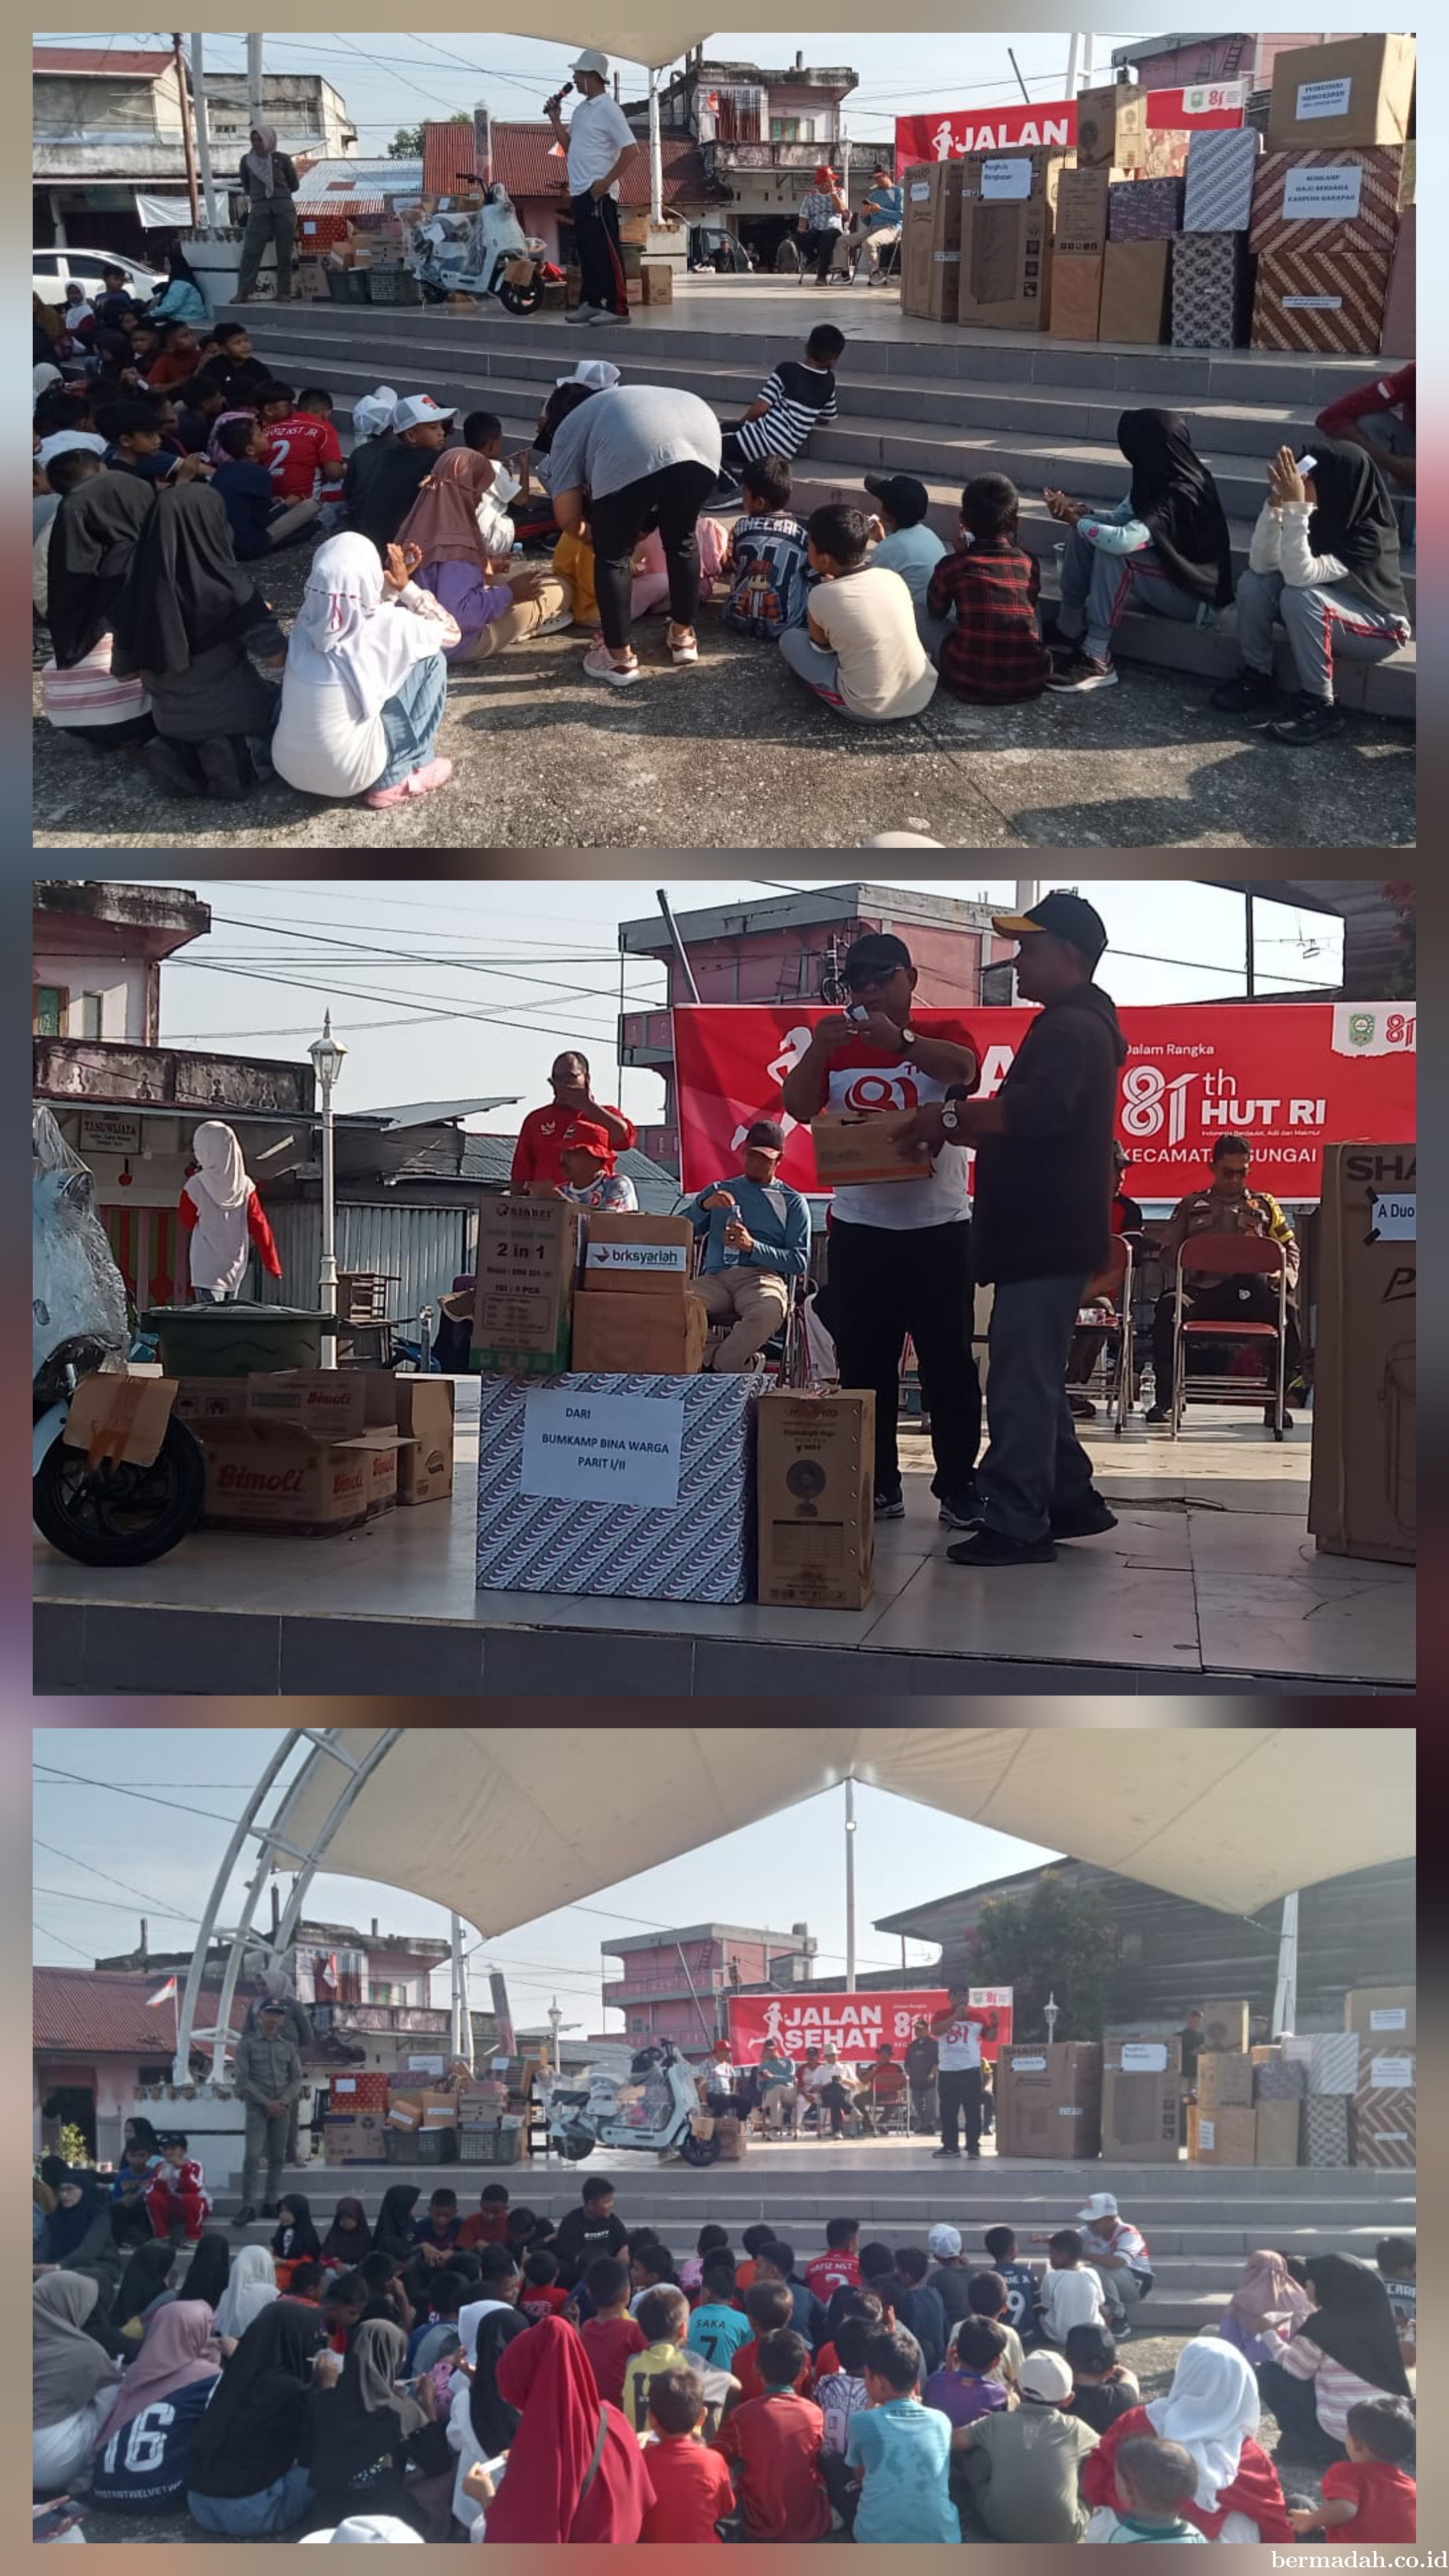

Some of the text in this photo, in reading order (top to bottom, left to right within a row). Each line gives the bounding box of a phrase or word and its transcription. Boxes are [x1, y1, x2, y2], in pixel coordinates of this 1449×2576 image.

[955, 119, 1068, 153] JALAN
[268, 439, 290, 476] 2
[1167, 1043, 1215, 1058] Rangka
[1122, 1065, 1236, 1146] 81 th
[1201, 1099, 1326, 1125] HUT RI
[1123, 1148, 1214, 1163] KECAMAT
[1378, 1205, 1415, 1218] A Duo
[497, 1242, 544, 1259] 2 in 1
[612, 1248, 678, 1265] brksyariah
[307, 1391, 352, 1405] Bimoli
[566, 1407, 591, 1419] DARI
[542, 1433, 669, 1454] BUMKAMP BINA WARGA
[577, 1456, 626, 1471] PARIT I/II
[216, 1464, 305, 1493] Bimoli
[784, 2005, 882, 2027] JALAN
[786, 2027, 883, 2051] SEHAT
[1007, 2290, 1026, 2325] 9
[696, 2318, 725, 2329] SAKA
[700, 2335, 718, 2361] 7
